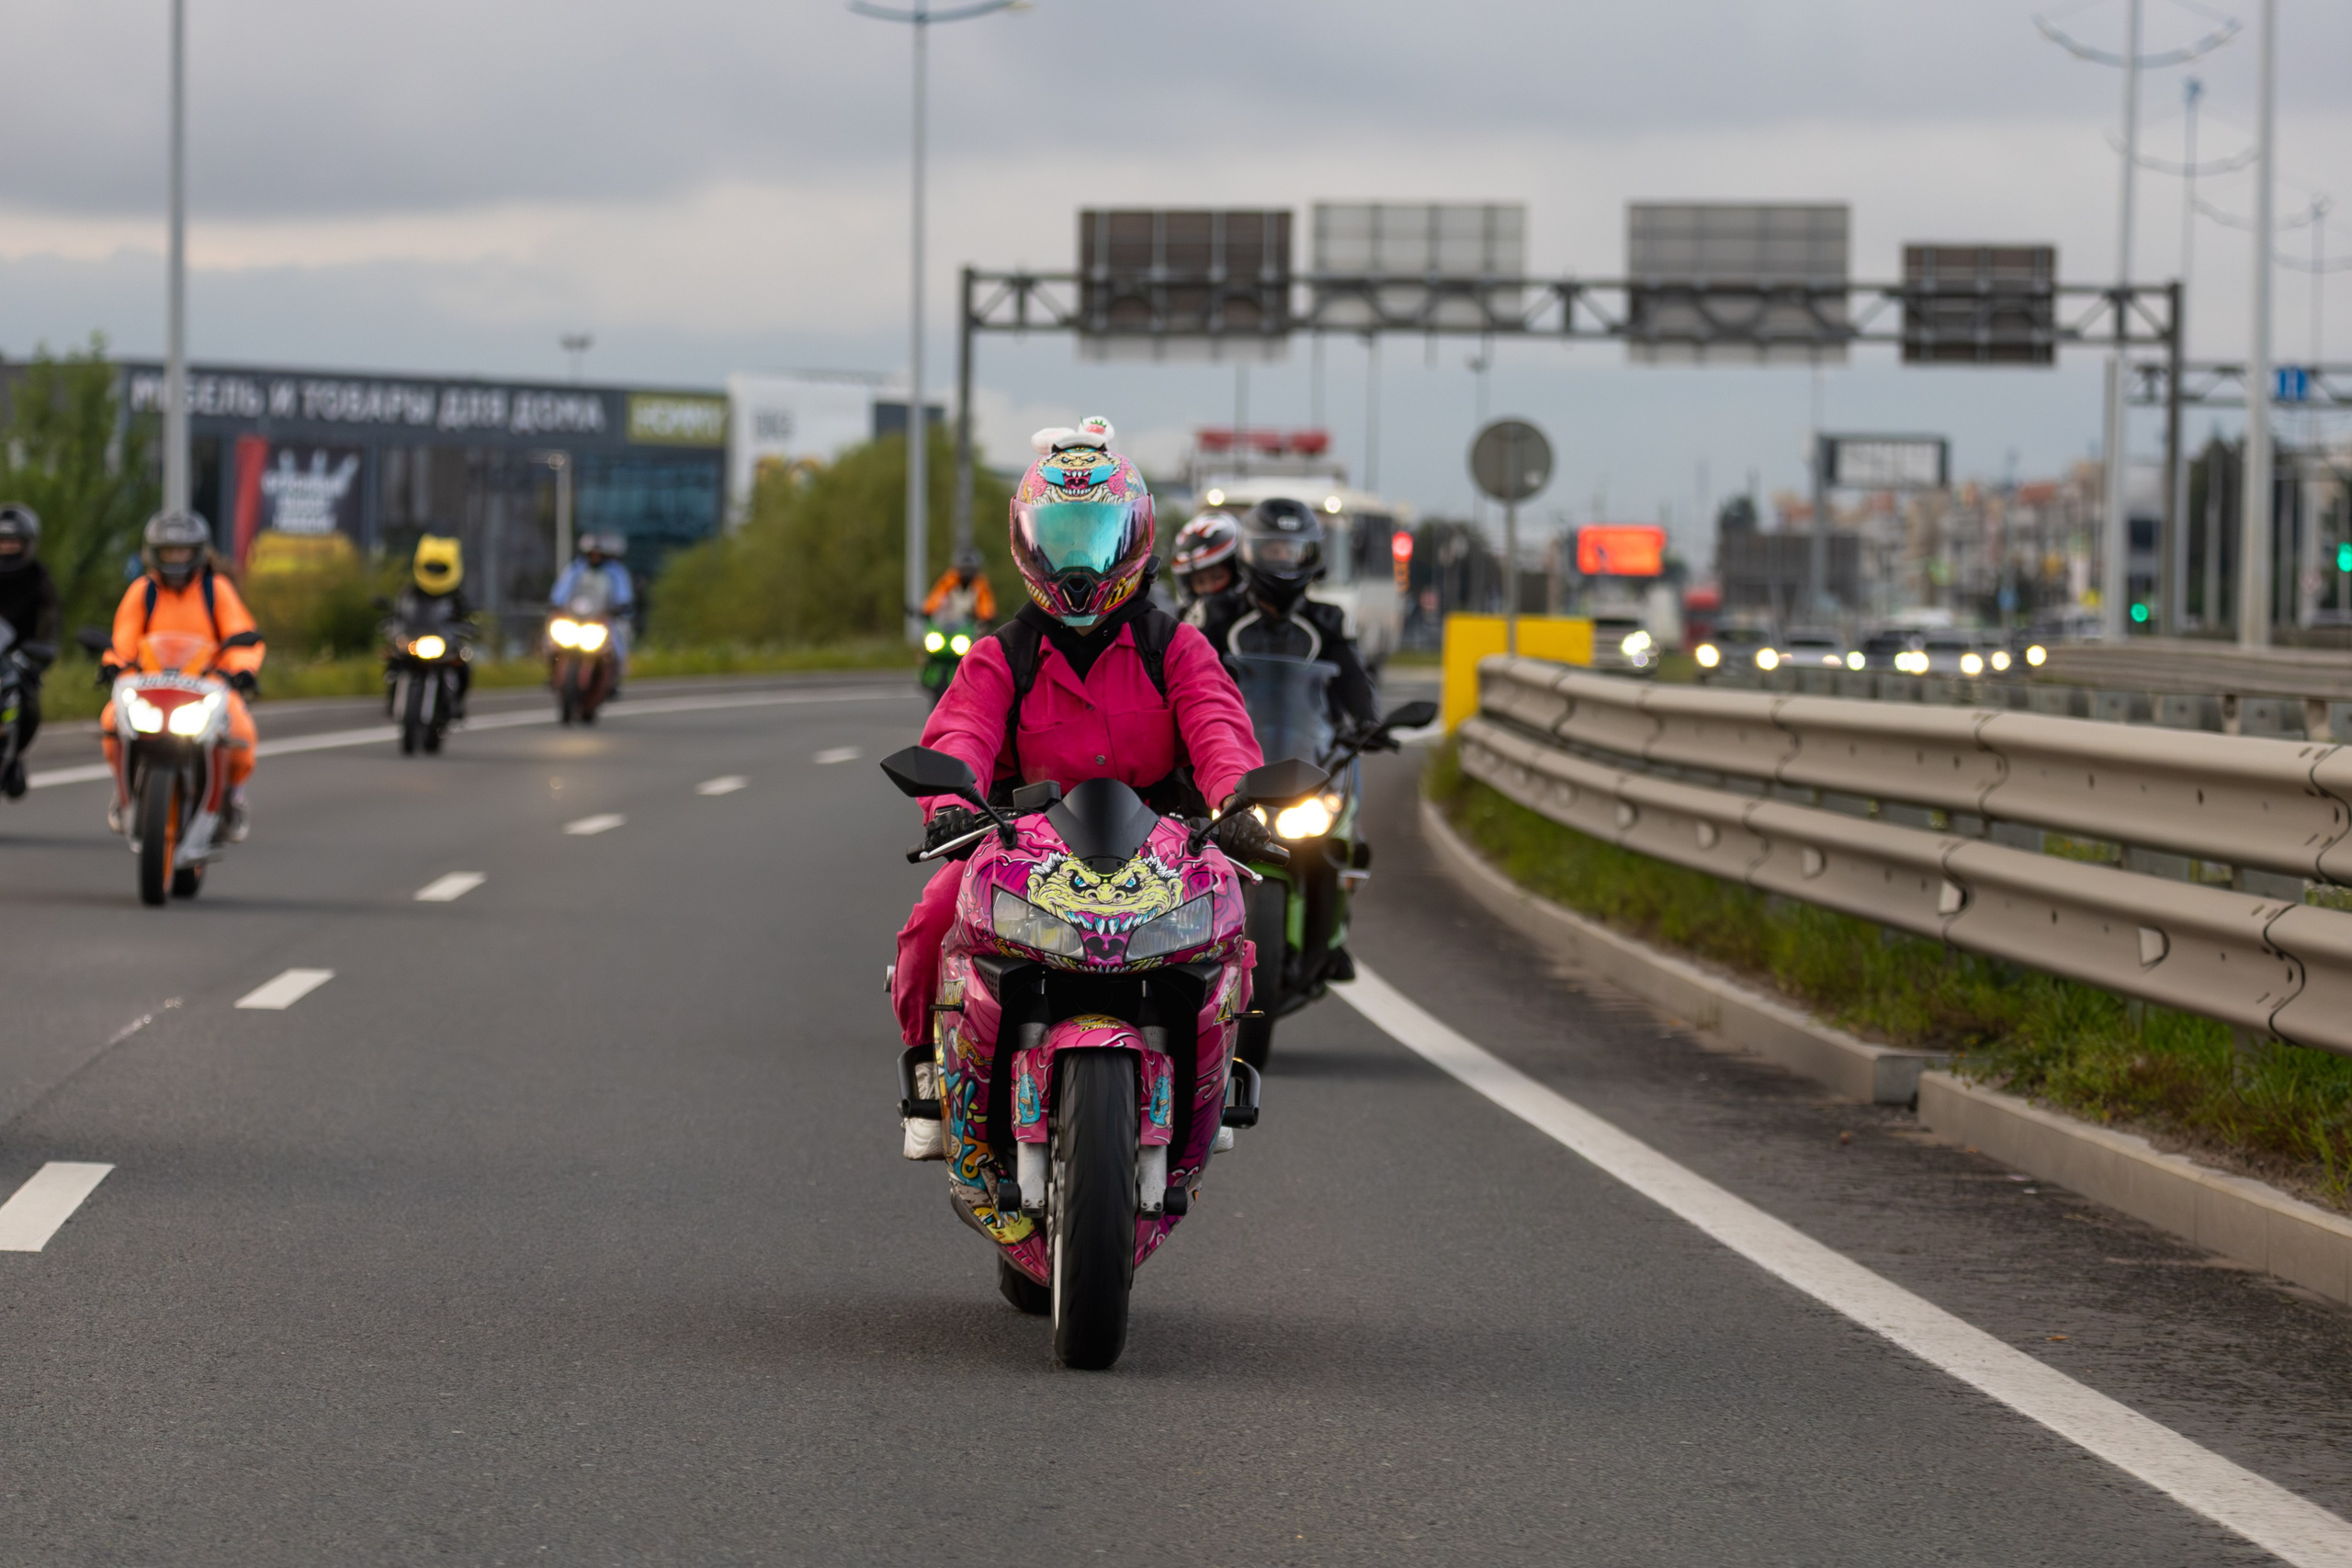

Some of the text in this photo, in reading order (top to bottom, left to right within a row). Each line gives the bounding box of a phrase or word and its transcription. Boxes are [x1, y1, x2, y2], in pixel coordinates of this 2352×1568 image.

[130, 372, 606, 435] МБЕЛЬ И ТОВАРЫ ДЛЯ ДОМА
